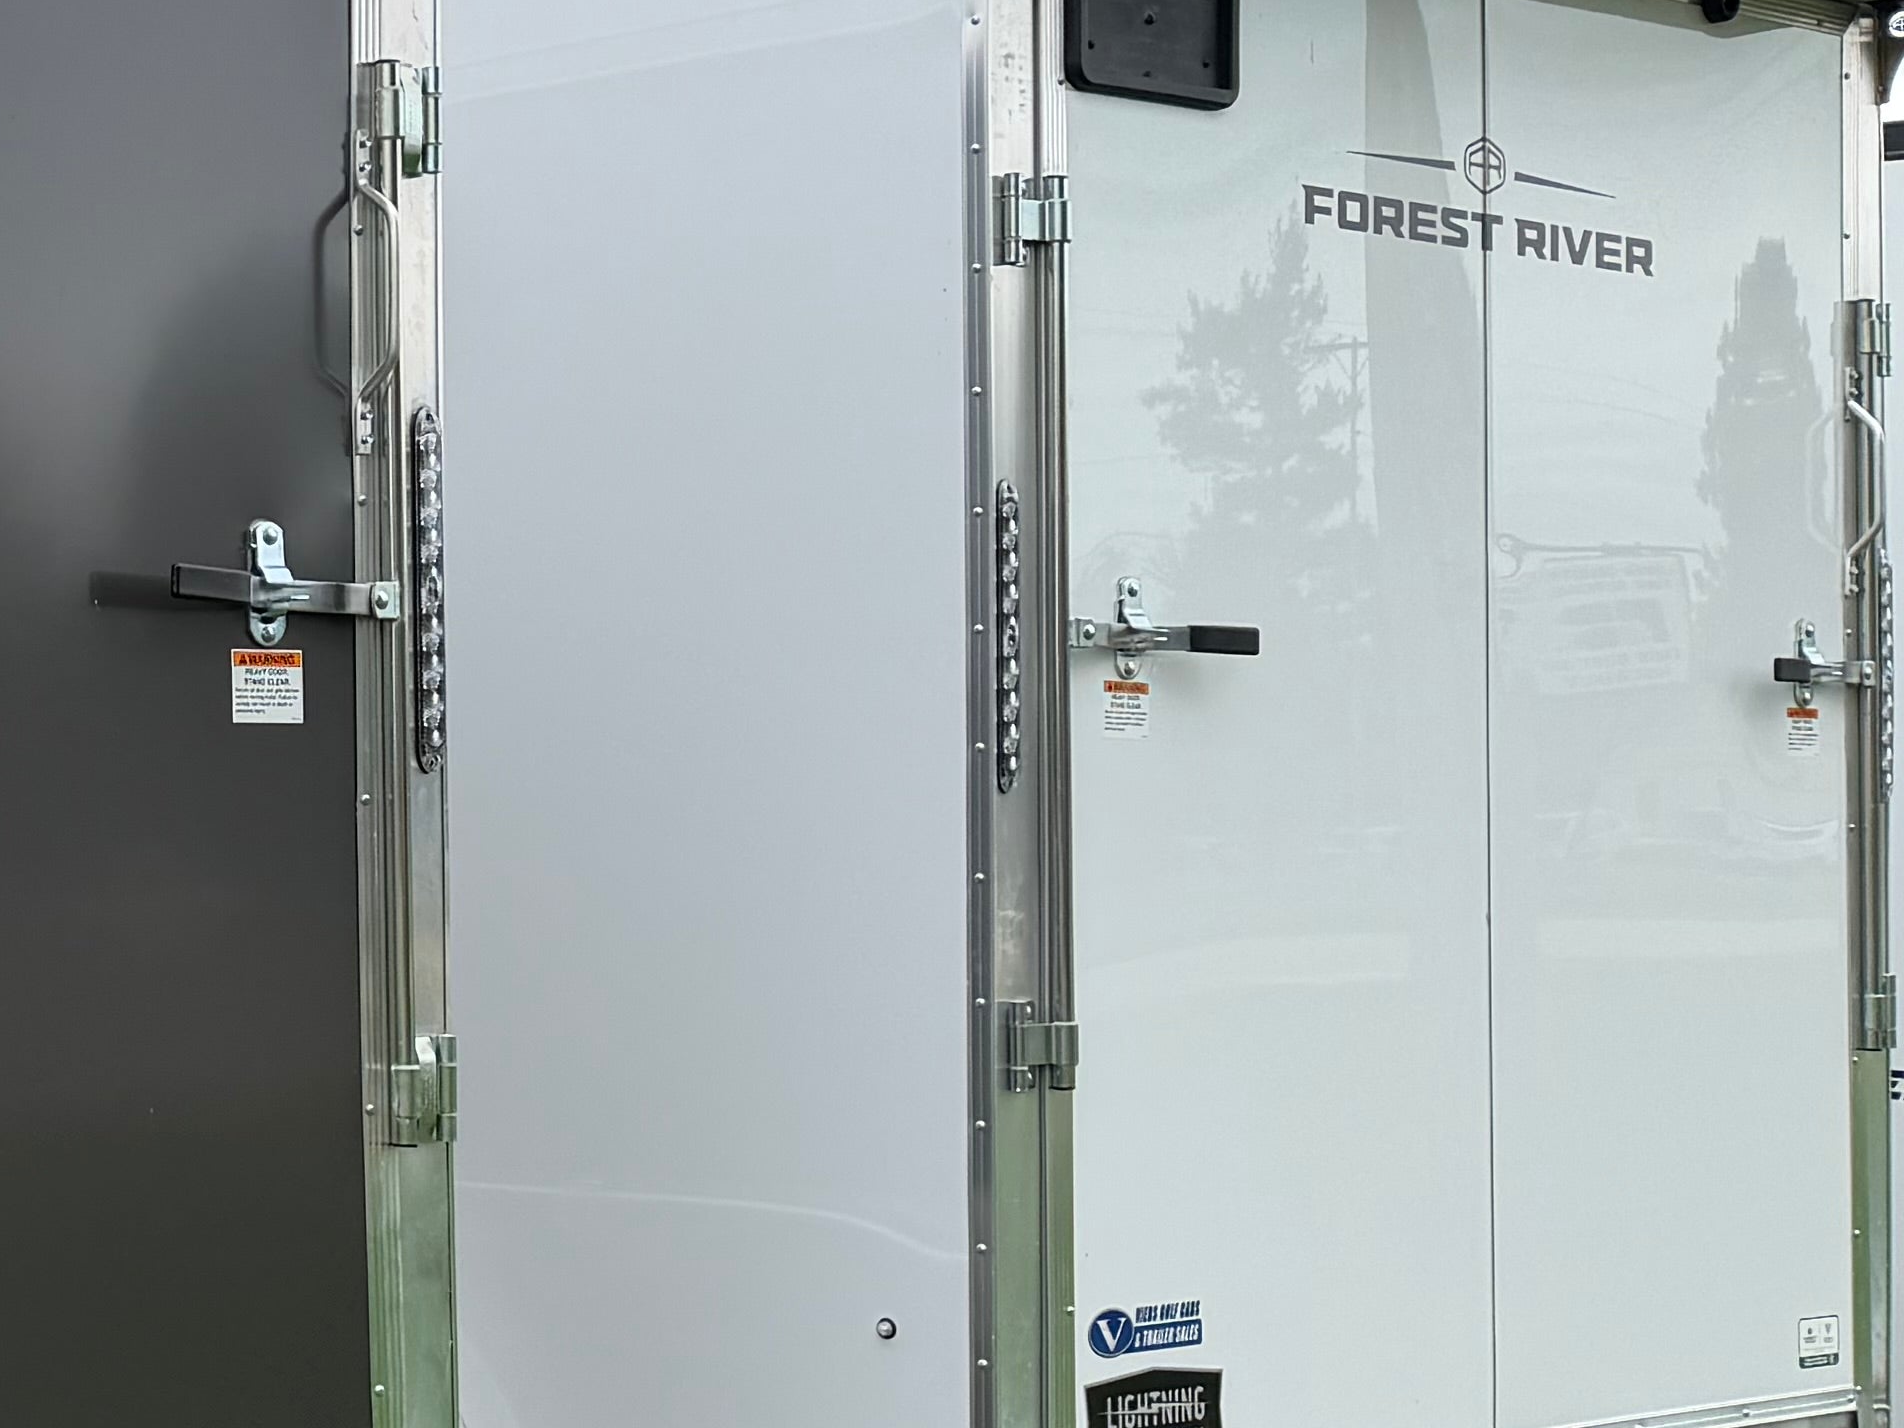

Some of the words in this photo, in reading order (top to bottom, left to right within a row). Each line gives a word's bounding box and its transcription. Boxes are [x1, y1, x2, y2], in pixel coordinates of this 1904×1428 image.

[1302, 184, 1503, 251] FOREST
[1514, 218, 1654, 277] RIVER
[1096, 1317, 1127, 1352] V
[1143, 1327, 1174, 1346] TRAILER
[1175, 1324, 1199, 1342] SALES
